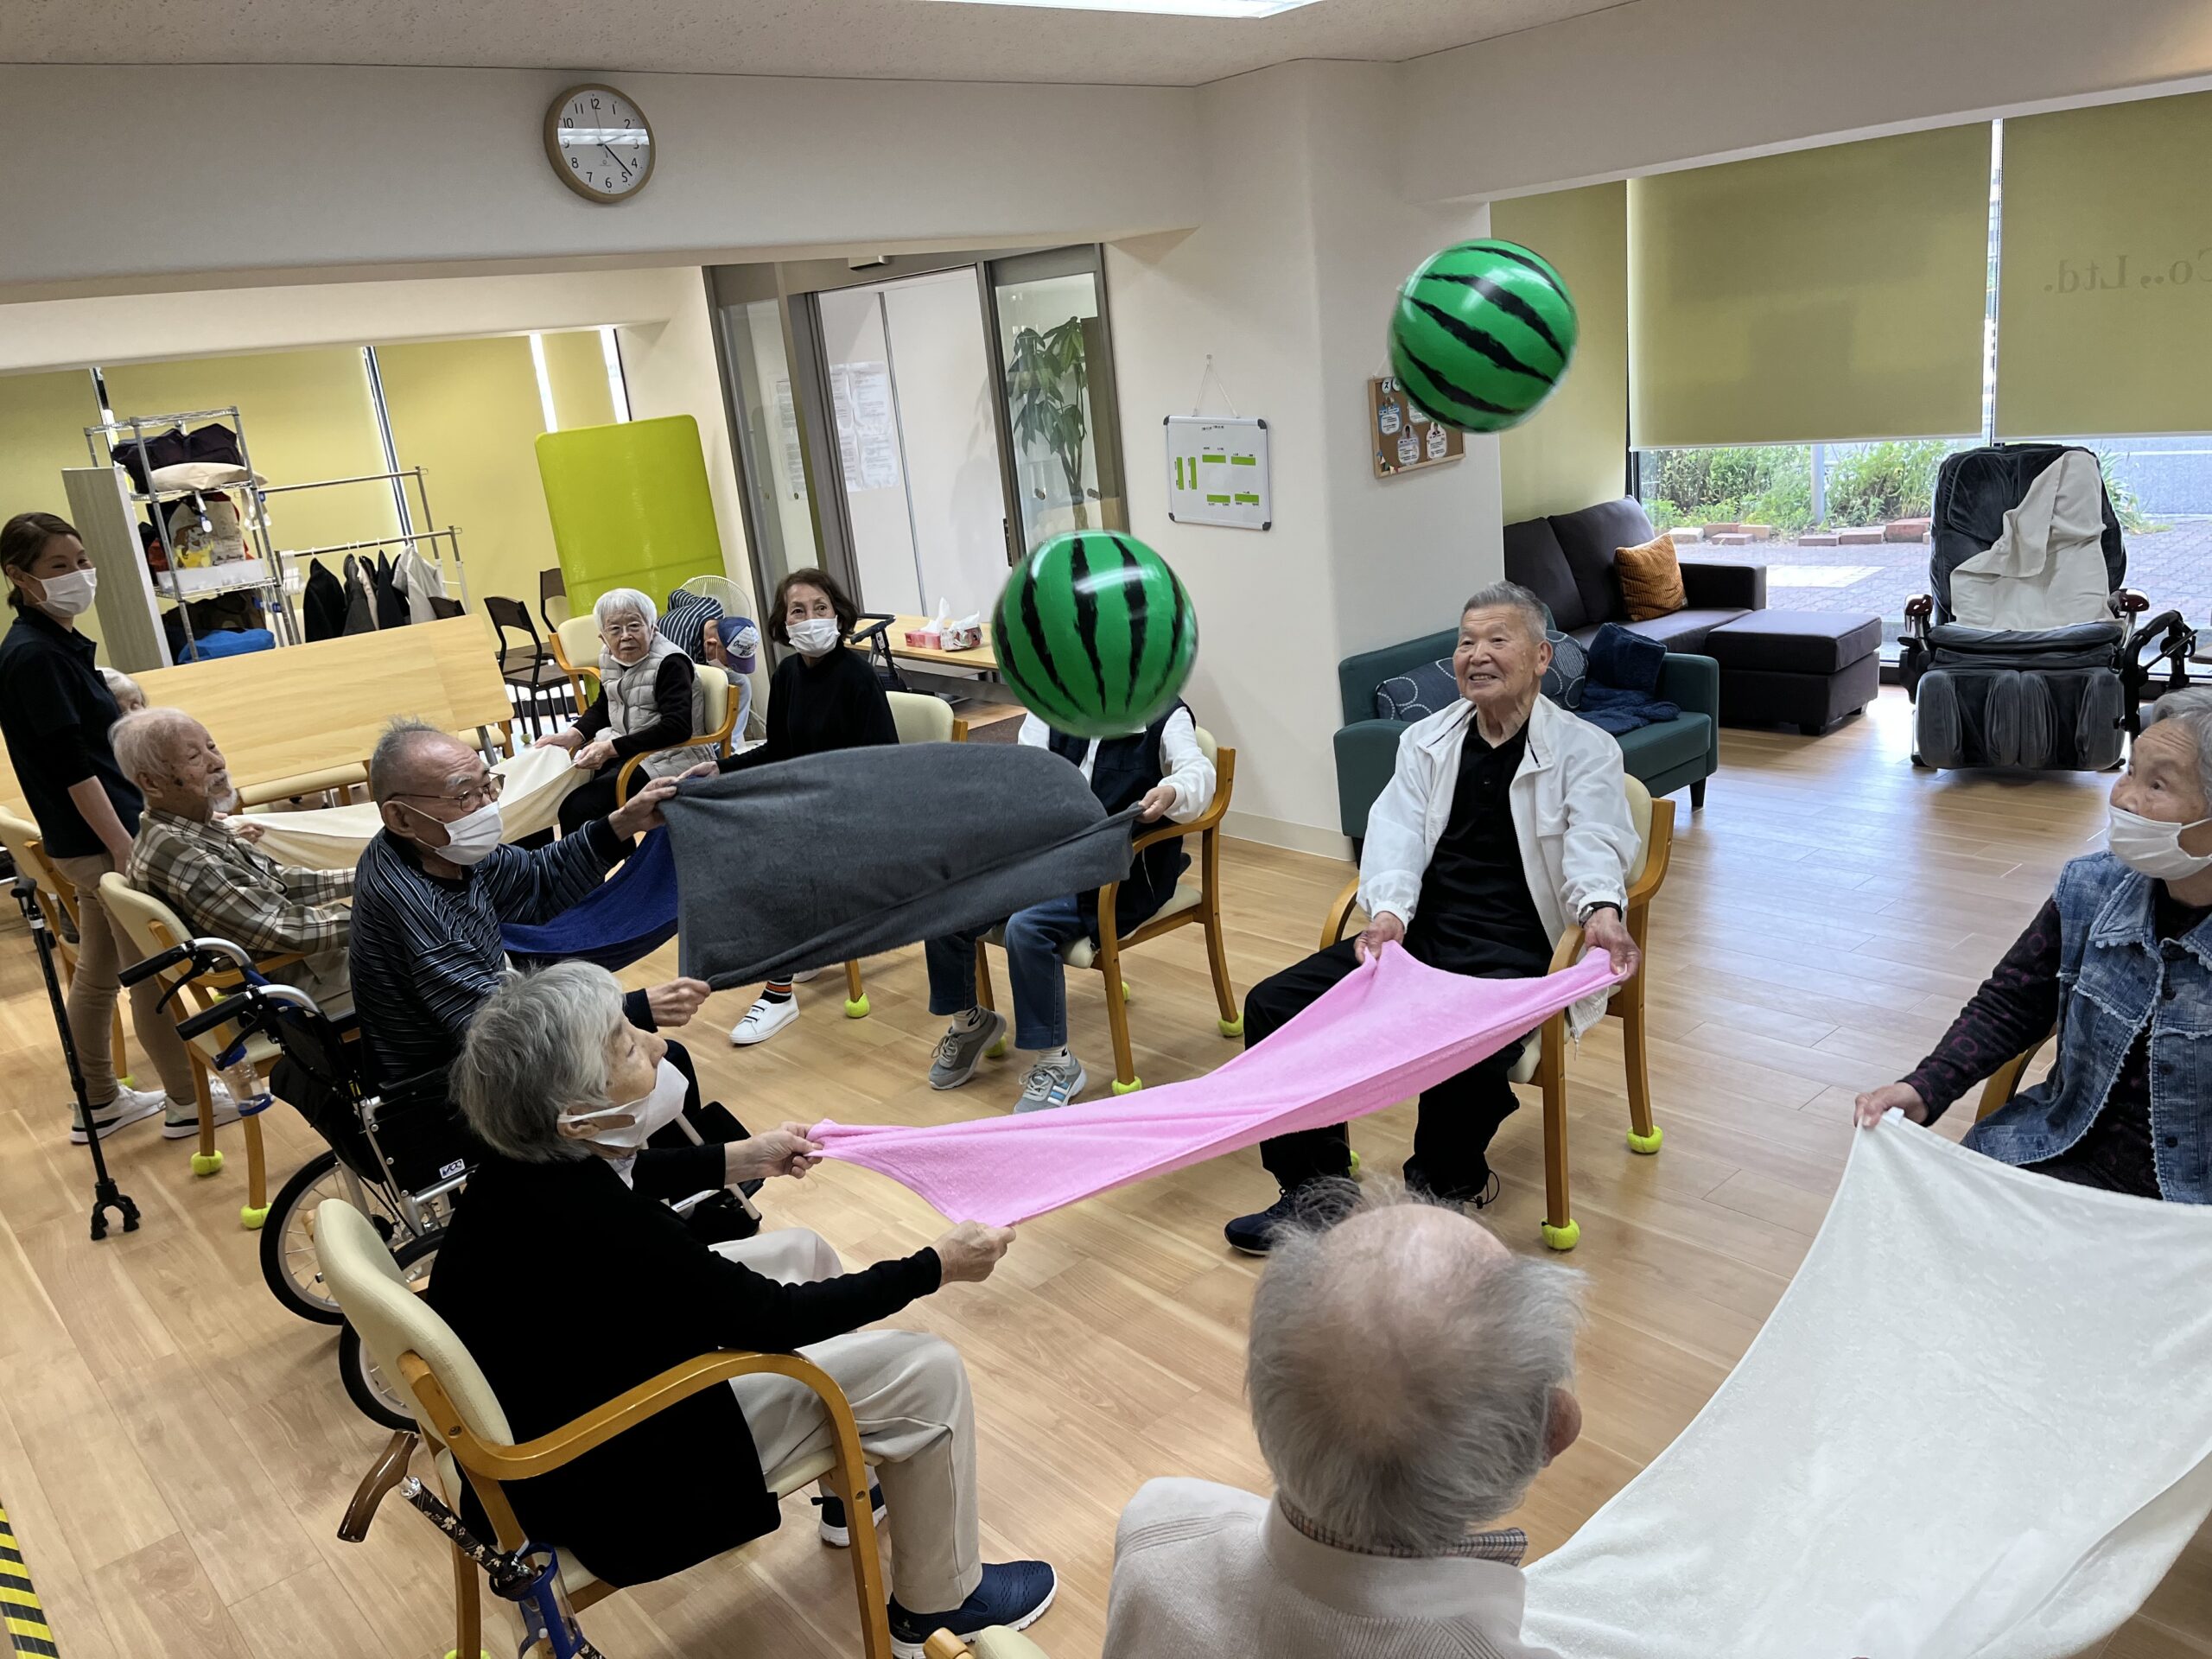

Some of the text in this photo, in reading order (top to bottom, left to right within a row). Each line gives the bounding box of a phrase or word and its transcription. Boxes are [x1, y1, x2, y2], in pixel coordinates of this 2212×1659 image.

[575, 103, 583, 114] 11
[590, 99, 601, 110] 12
[612, 104, 616, 115] 1
[563, 118, 574, 129] 10
[624, 119, 632, 129] 2
[571, 157, 579, 168] 8
[631, 157, 638, 168] 4
[587, 172, 593, 182] 7
[605, 177, 613, 188] 6
[621, 172, 628, 182] 5
